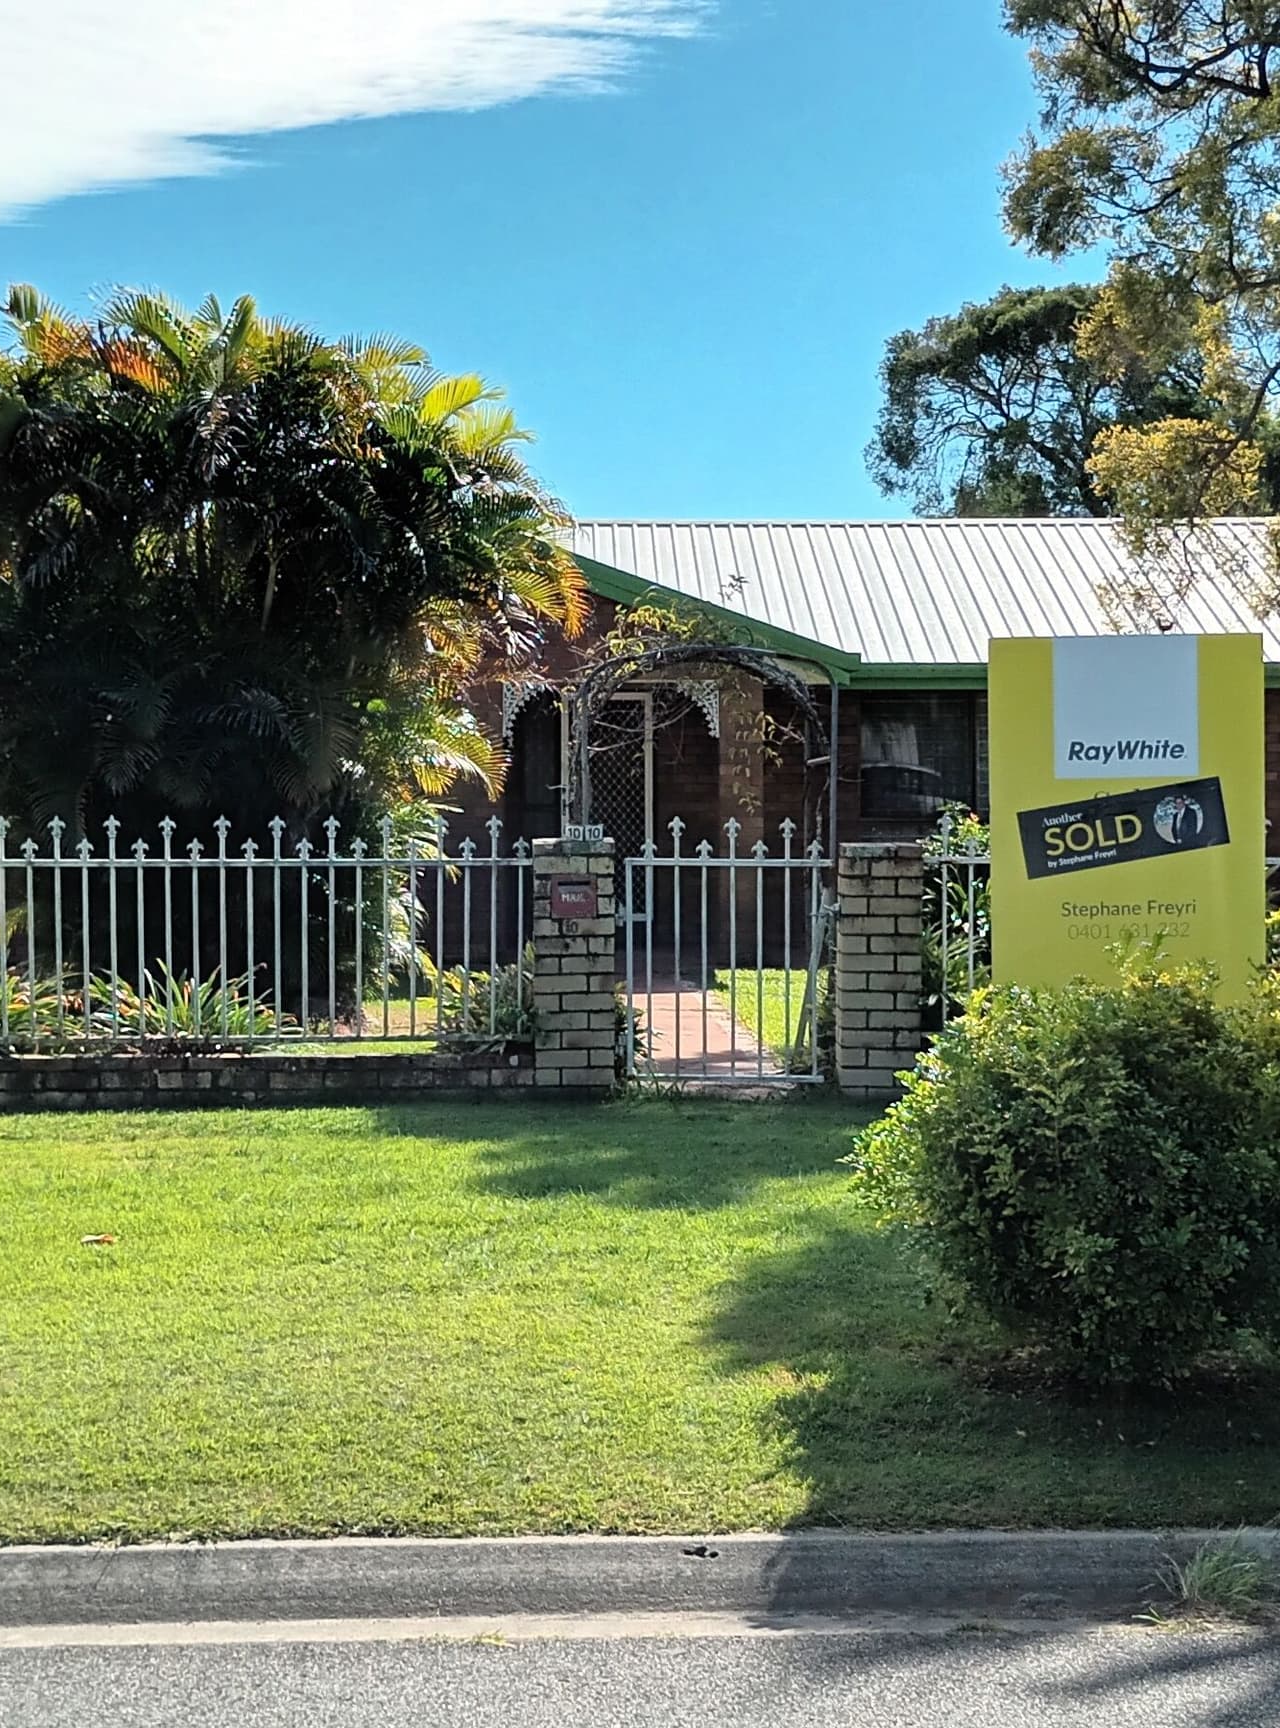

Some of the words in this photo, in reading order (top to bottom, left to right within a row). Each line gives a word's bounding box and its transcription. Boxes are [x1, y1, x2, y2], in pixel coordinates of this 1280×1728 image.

[1042, 812, 1083, 828] Another
[568, 827, 581, 839] 10
[588, 827, 601, 839] 10
[1044, 814, 1142, 856] SOLD
[1047, 860, 1058, 868] by
[1058, 853, 1094, 867] Stephane
[1061, 901, 1141, 919] Stephane
[1147, 899, 1196, 917] Freyri
[1067, 923, 1111, 940] 0401
